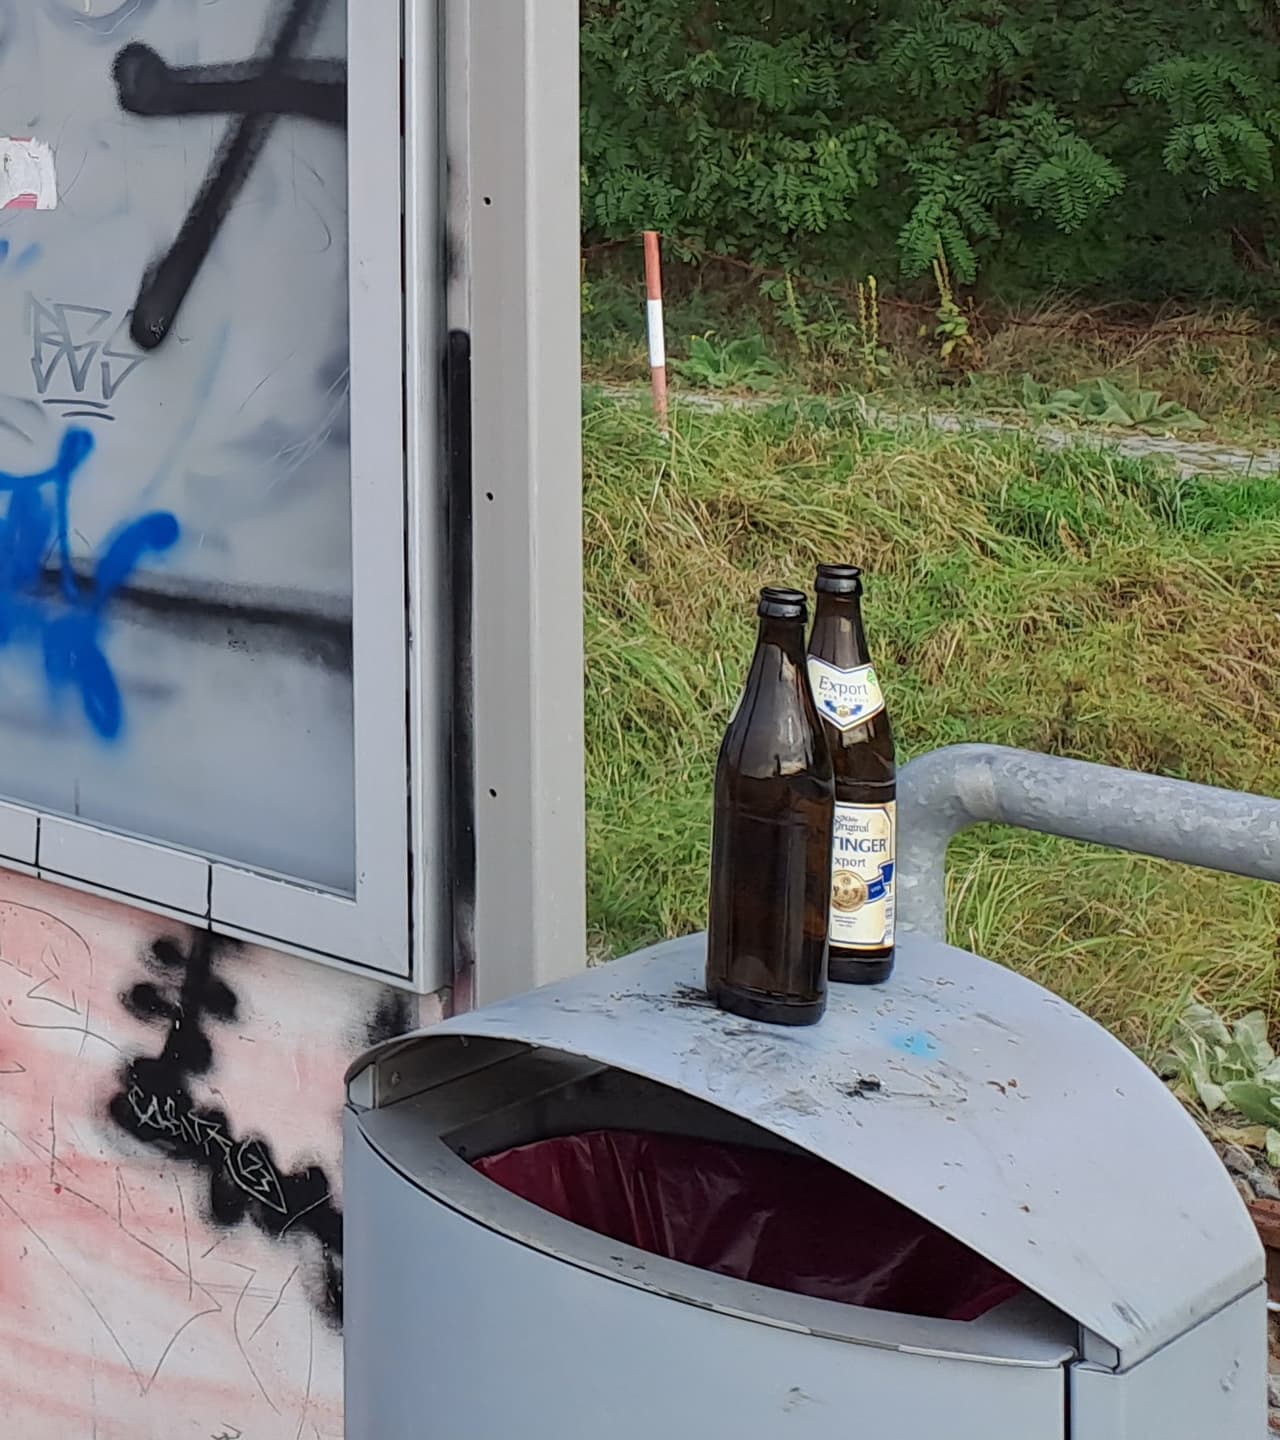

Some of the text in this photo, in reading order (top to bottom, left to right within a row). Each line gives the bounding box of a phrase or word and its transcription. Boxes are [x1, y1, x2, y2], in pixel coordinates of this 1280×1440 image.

[819, 675, 868, 697] Export
[832, 836, 887, 852] TINGER
[835, 857, 866, 868] xport
